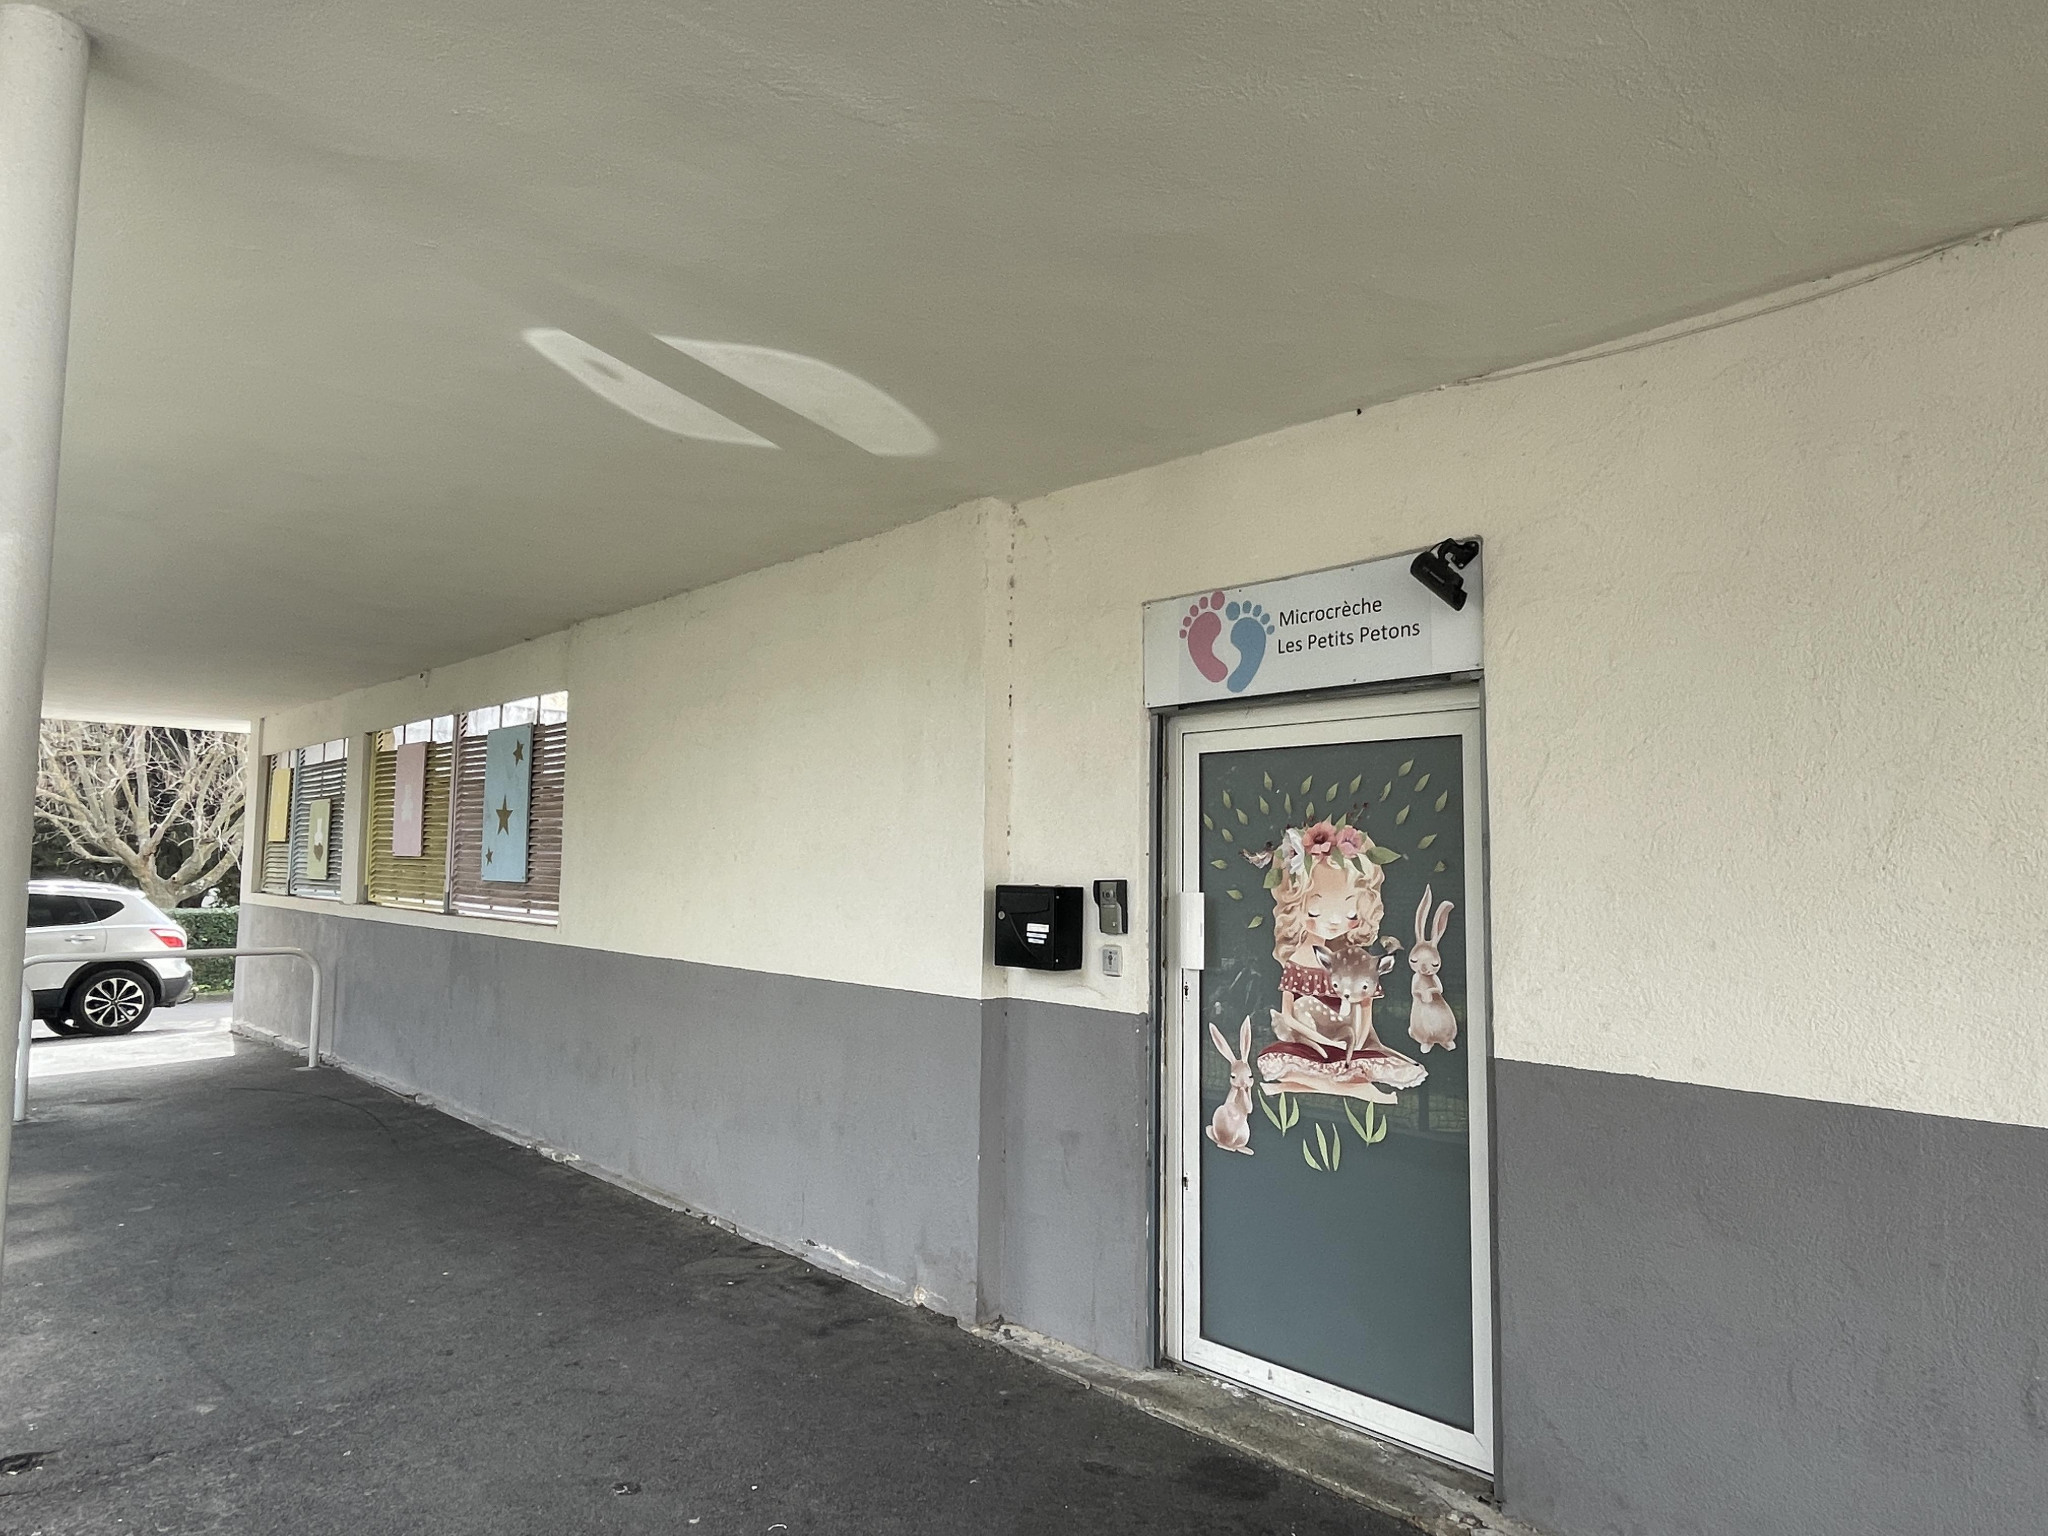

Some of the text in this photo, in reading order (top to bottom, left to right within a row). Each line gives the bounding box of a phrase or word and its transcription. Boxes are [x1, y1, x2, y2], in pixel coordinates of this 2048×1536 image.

[1279, 598, 1382, 627] Microcrèche
[1277, 622, 1421, 654] Les Petits Petons
